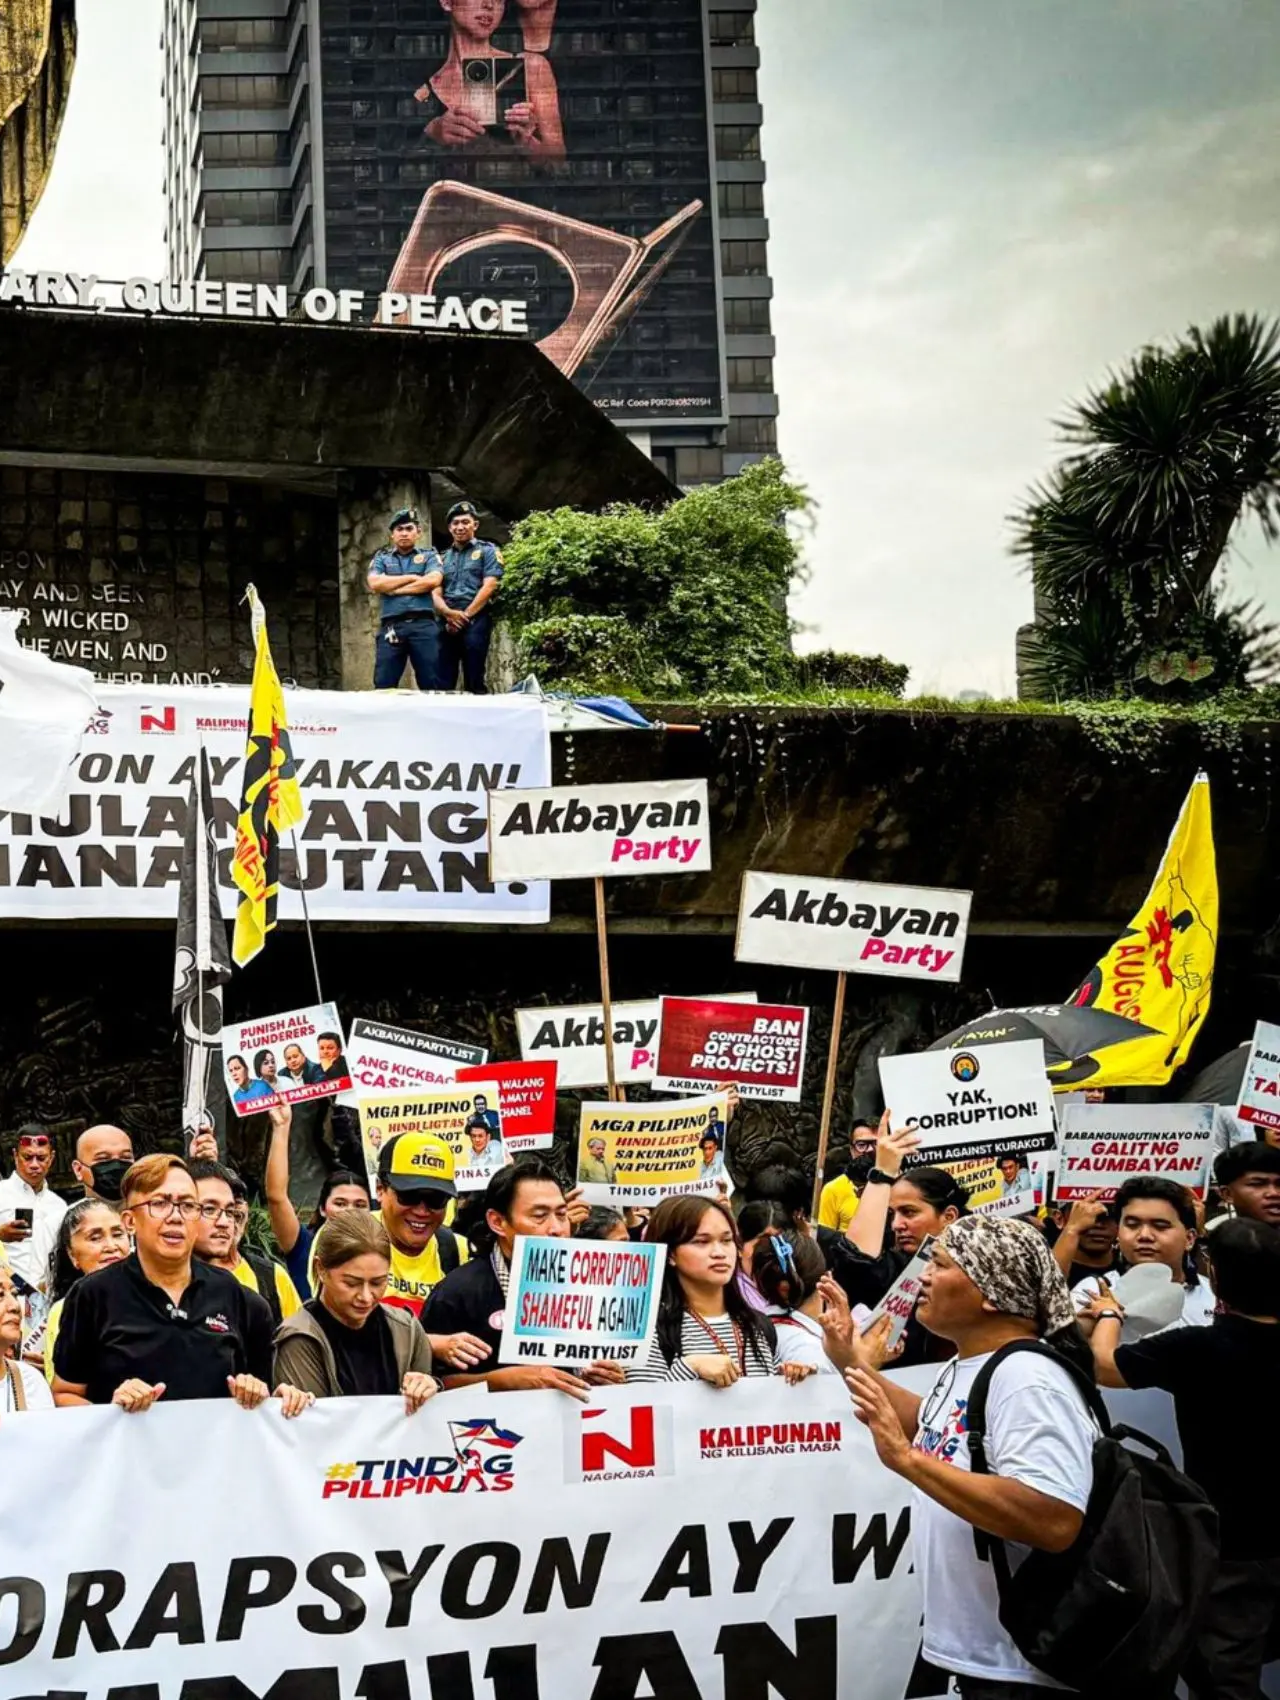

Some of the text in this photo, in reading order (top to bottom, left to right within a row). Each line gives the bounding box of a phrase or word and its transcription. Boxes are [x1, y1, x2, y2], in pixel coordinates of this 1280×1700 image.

[123, 276, 288, 319] QUEEN
[304, 287, 365, 322] OF
[380, 292, 528, 333] PEACE
[33, 582, 80, 601] AND
[42, 609, 129, 631] WICKED
[122, 642, 168, 661] AND
[300, 800, 487, 844] ANG
[499, 799, 701, 837] Akbayan
[611, 836, 701, 863] Party
[750, 888, 960, 938] Akbayan
[860, 938, 955, 972] Party
[240, 1014, 309, 1039] PUNISH ALL
[753, 1018, 801, 1036] BAN
[239, 1025, 315, 1051] PLUNDERERS
[362, 1027, 476, 1061] AKBAYAN PARTYLIST
[708, 1031, 801, 1047] CONTRACTORS
[704, 1042, 799, 1061] OF GHOST
[357, 1055, 388, 1072] ANG
[690, 1054, 797, 1075] PROJECTS!
[289, 1080, 341, 1099] PARTYLIST
[502, 1078, 545, 1088] WALANG
[530, 1092, 543, 1101] LV
[946, 1088, 992, 1108] YAK,
[367, 1100, 471, 1119] MGA PILIPINO
[905, 1101, 1038, 1131] CORRUPTION!
[388, 1118, 466, 1133] HINDI LIGTAS
[590, 1113, 707, 1133] MGA PILIPINO
[506, 1138, 536, 1148] YOUTH
[615, 1132, 701, 1147] HINDI LIGTAS
[1163, 1131, 1192, 1140] KAYO
[1194, 1131, 1210, 1140] NG
[615, 1145, 697, 1159] SA KURAKOT
[905, 1137, 1047, 1164] YOUTH AGAINST KURAKOT
[1091, 1142, 1179, 1156] GALIT NG
[614, 1158, 696, 1172] NA PULITIKO
[1066, 1156, 1202, 1172] TAUMBAYAN!
[609, 1179, 714, 1196] TINDIG PILIPINAS
[526, 1247, 650, 1288] MAKE CORRUPTION
[521, 1291, 647, 1336] SHAMEFUL AGAIN!
[518, 1341, 638, 1360] ML PARTYLIST
[699, 1421, 841, 1448] KALIPUNAN
[700, 1449, 723, 1460] NG
[799, 1442, 842, 1454] MASA
[582, 1470, 655, 1482] NAGKAISA
[639, 1515, 796, 1603] AY
